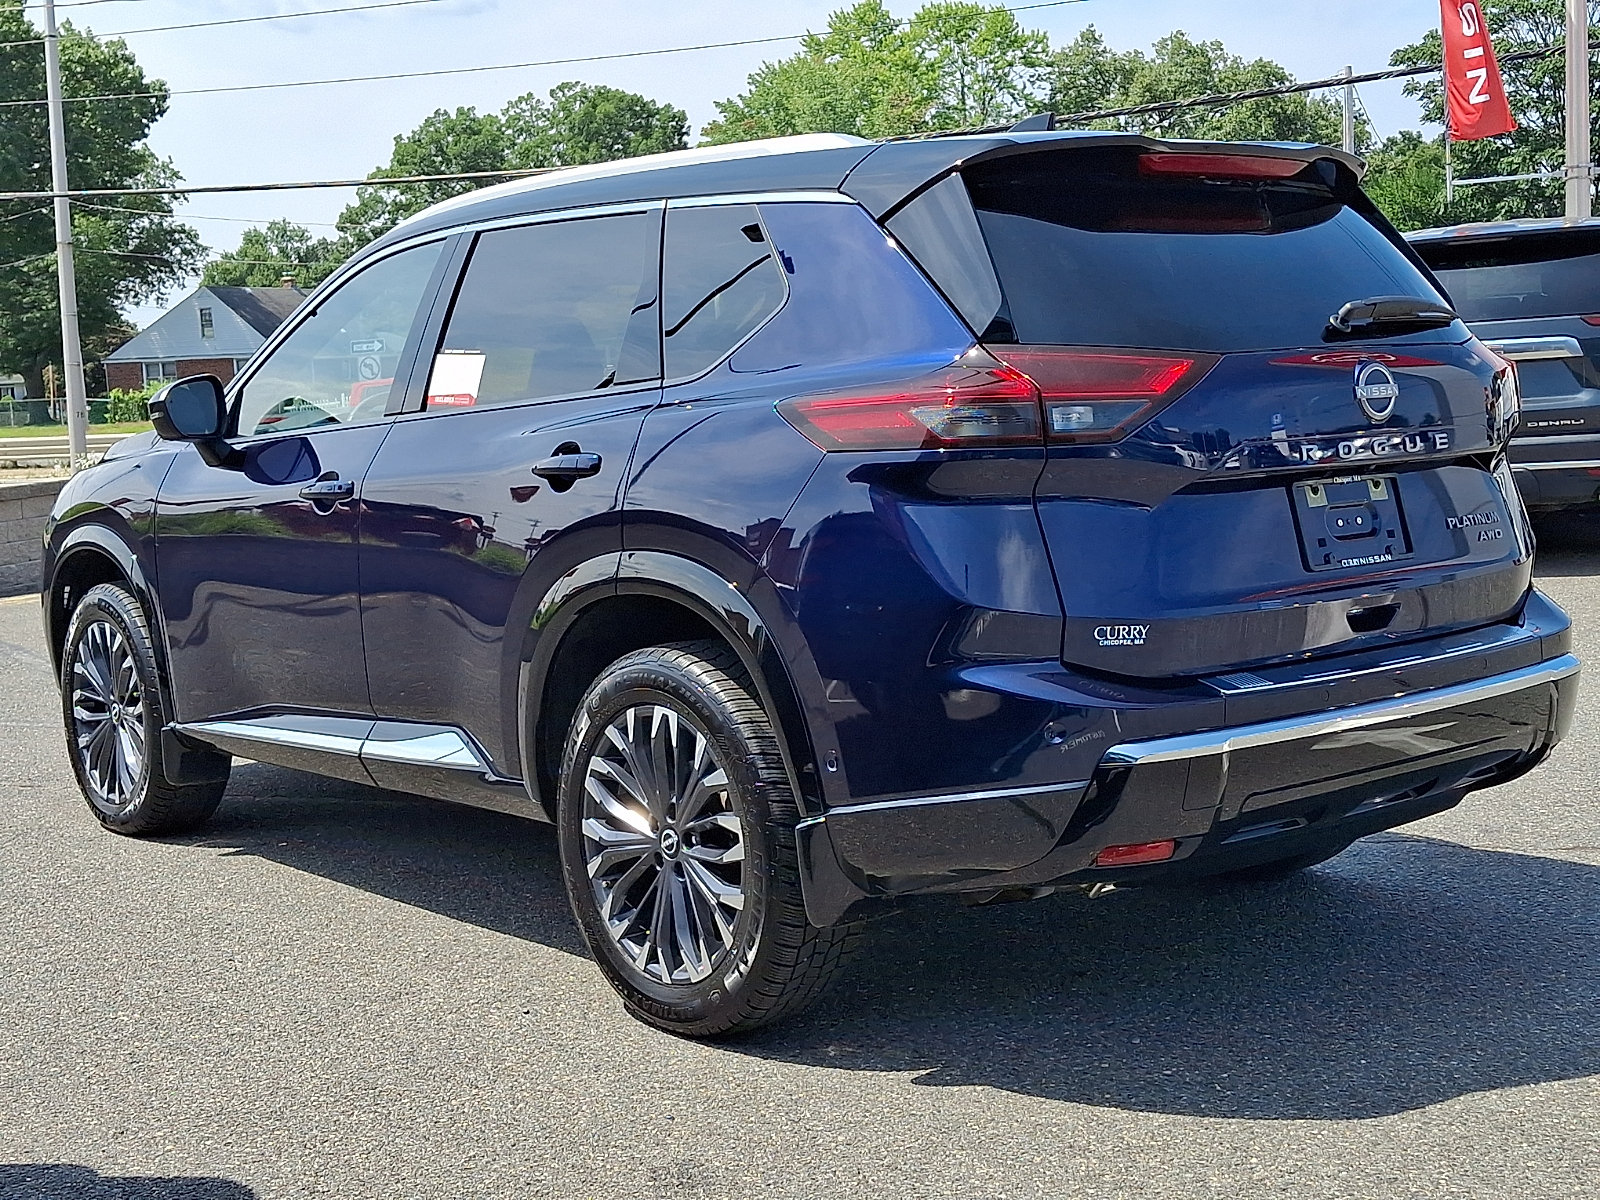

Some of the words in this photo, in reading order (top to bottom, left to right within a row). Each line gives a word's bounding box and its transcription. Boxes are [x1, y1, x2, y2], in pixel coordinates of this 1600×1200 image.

[1356, 385, 1399, 398] NISSAN
[1527, 419, 1585, 427] DENALI
[1300, 433, 1449, 461] ROGUE
[1446, 511, 1501, 529] PLATINUM
[1480, 528, 1503, 541] AWD
[1360, 554, 1391, 564] NISSAN
[1094, 624, 1151, 640] CURRY
